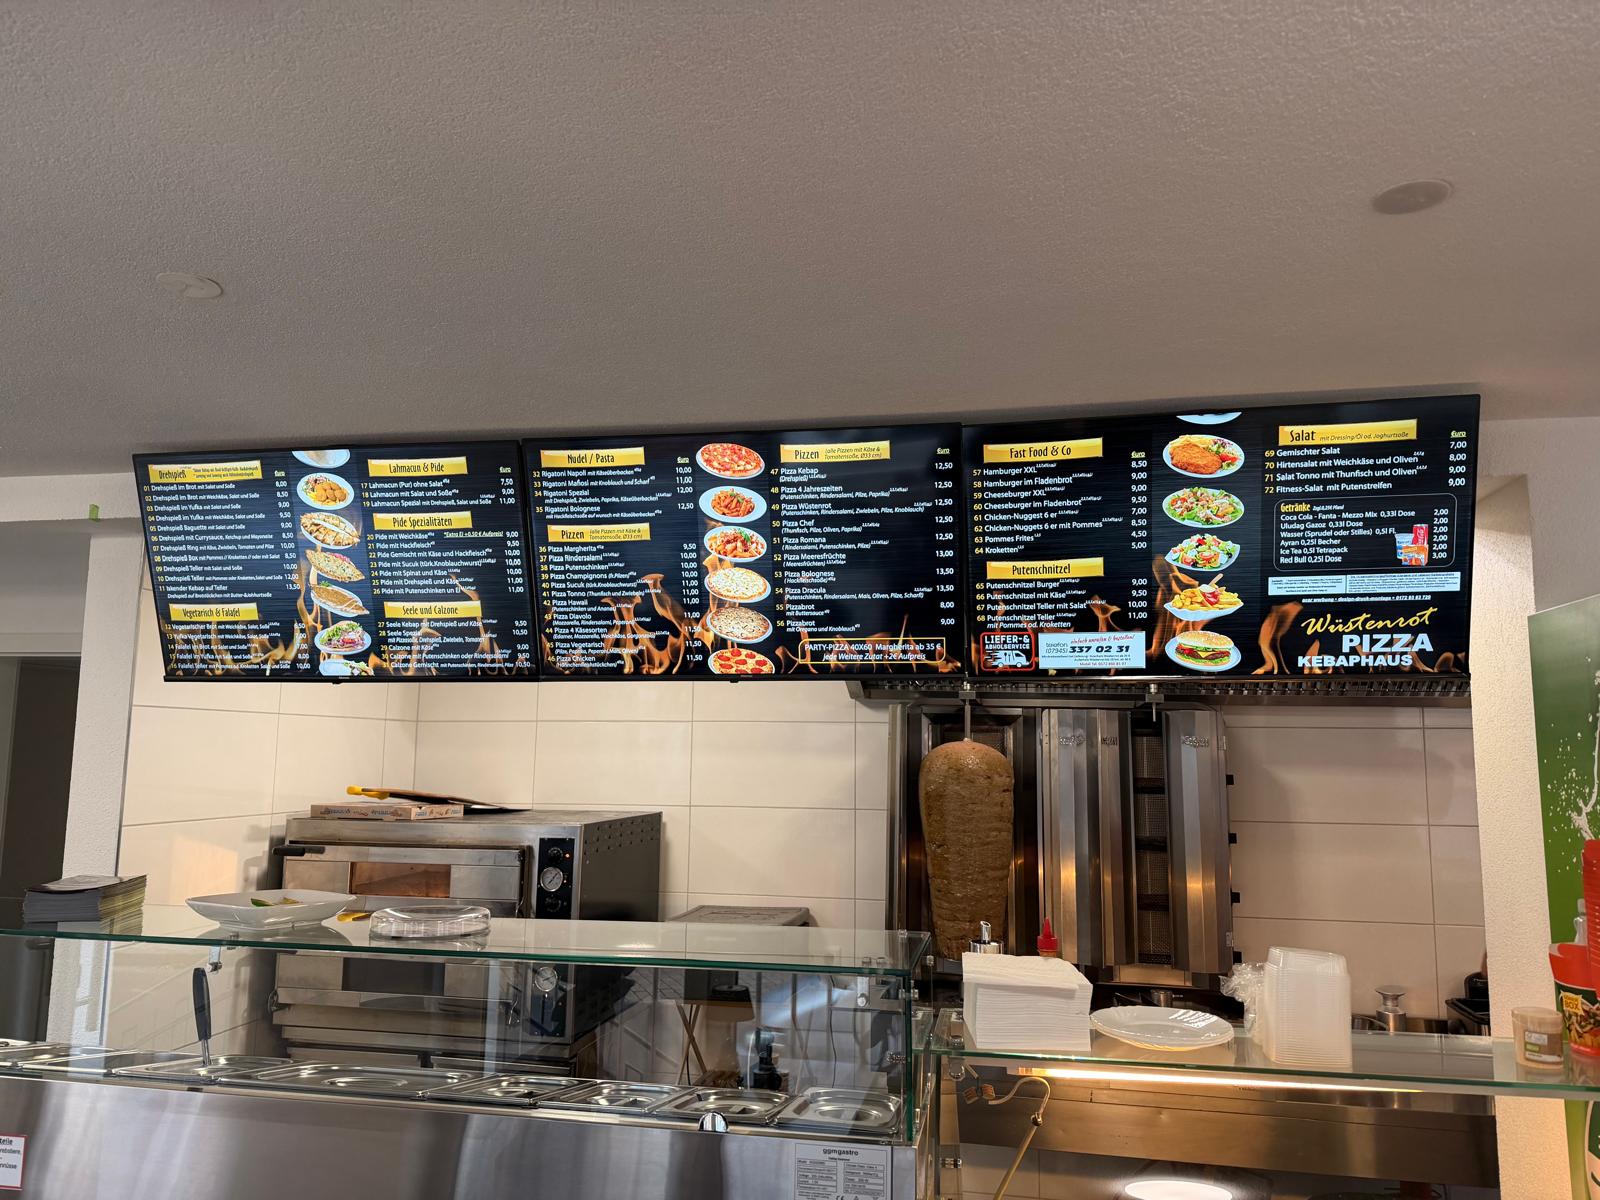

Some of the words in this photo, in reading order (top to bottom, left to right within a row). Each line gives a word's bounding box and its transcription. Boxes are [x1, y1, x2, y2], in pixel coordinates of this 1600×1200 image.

[1290, 430, 1316, 442] Salat
[795, 450, 819, 459] Pizzen
[1010, 448, 1025, 458] Fast
[1029, 447, 1047, 457] Food
[1051, 446, 1058, 456] &
[1062, 446, 1071, 455] Co
[1277, 449, 1320, 457] Gemischter
[568, 453, 587, 464] Nudel
[596, 453, 614, 463] Pasta
[1277, 460, 1318, 469] Hirtensalat
[1334, 458, 1374, 466] Weichkäse
[389, 464, 420, 473] Lahmacun
[423, 464, 428, 472] &
[431, 463, 444, 472] Pide
[798, 468, 818, 476] Kebap
[159, 470, 186, 479] Drehspieß
[984, 480, 1022, 488] Hamburger
[1276, 485, 1323, 493] Fitness-Salat
[1341, 482, 1392, 490] Putenstreifen
[1448, 478, 1465, 486] 9,00
[1281, 503, 1310, 512] Getränke
[393, 517, 407, 527] Pide
[409, 516, 452, 528] Spezialitäten
[984, 524, 1043, 532] Chicken-Nuggets
[562, 530, 584, 539] Pizzen
[1317, 547, 1348, 555] Tetrapack
[1012, 564, 1070, 575] Putenschnitzel
[183, 608, 214, 619] Vegetarisch
[222, 608, 240, 617] Falafel
[403, 606, 418, 615] Seele
[420, 606, 432, 614] und
[434, 605, 458, 615] Calzone
[1301, 607, 1438, 635] Wüstenrot
[1342, 634, 1433, 652] PIZZA
[1298, 655, 1412, 667] KEBAPHAUS
